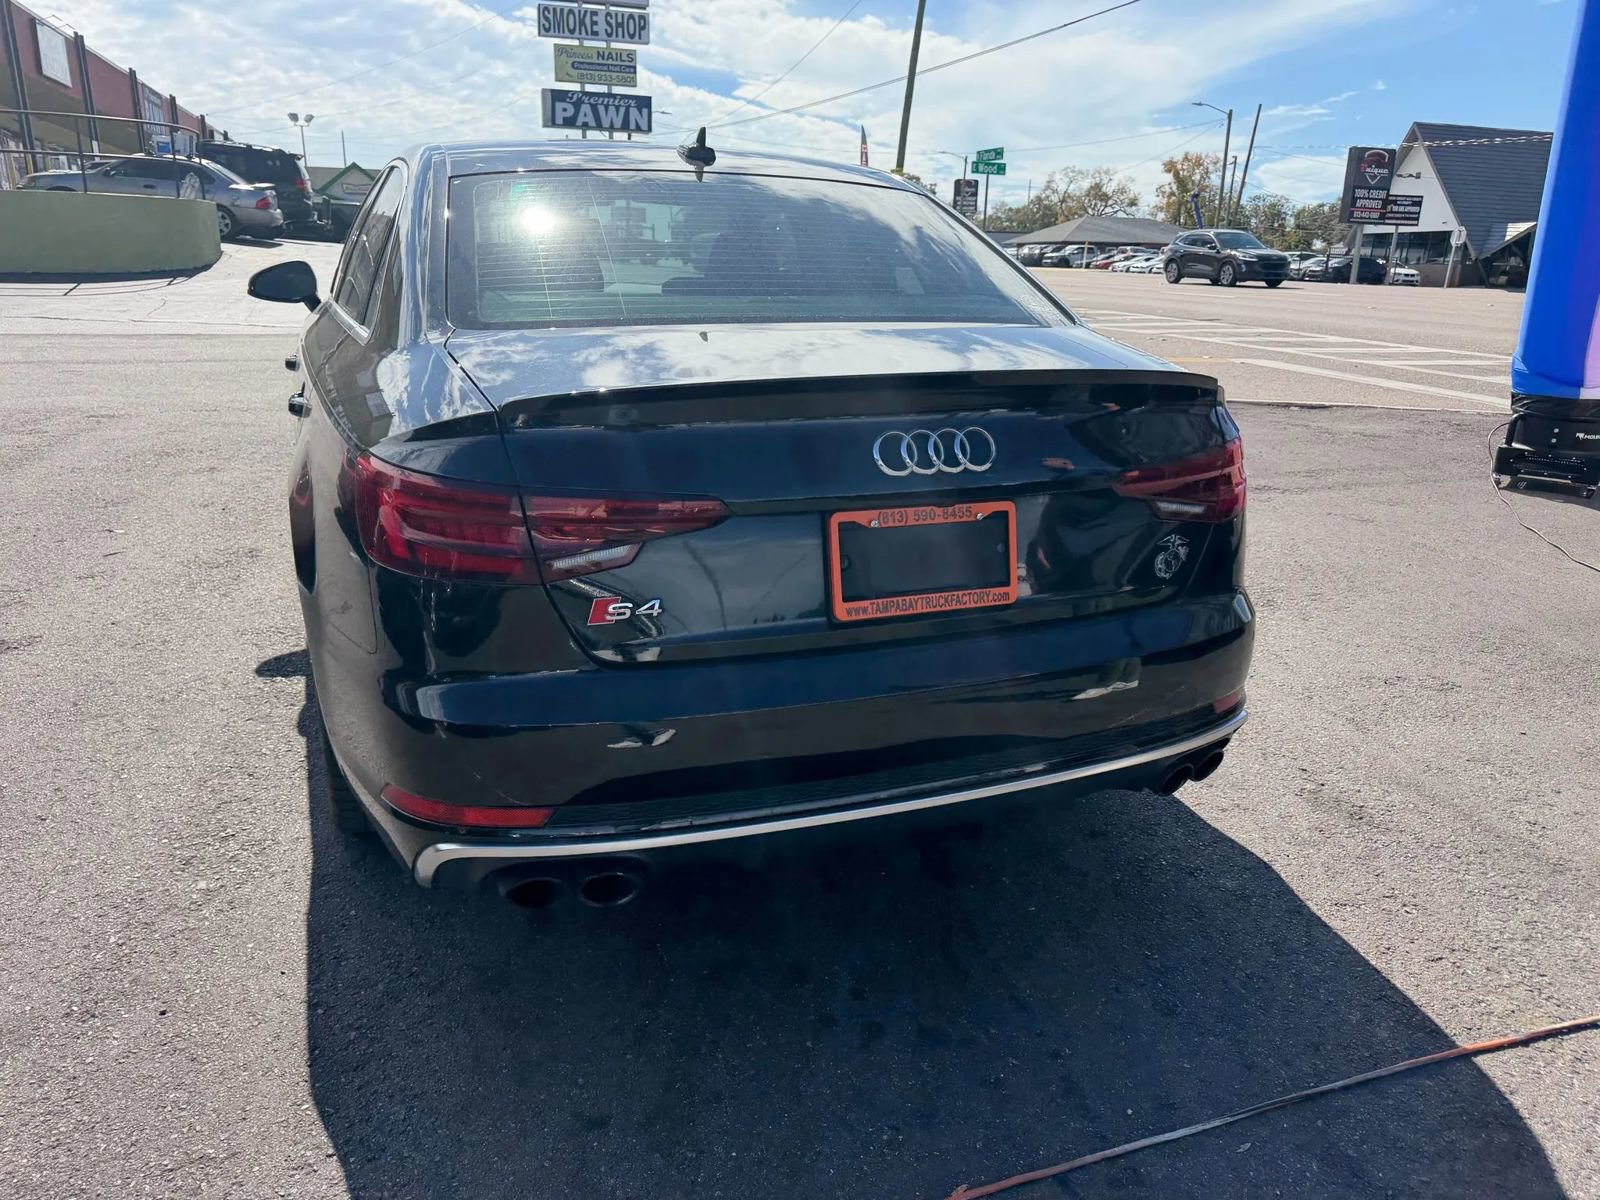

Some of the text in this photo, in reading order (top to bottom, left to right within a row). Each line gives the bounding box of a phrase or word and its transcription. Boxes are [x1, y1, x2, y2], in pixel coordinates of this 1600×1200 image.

[542, 5, 647, 40] SMOKE SHOP
[597, 50, 634, 63] NAILS
[577, 72, 596, 81] (813)
[566, 91, 638, 107] Premier
[555, 101, 649, 131] PAWN
[1369, 189, 1387, 199] CREDIT
[1355, 199, 1382, 209] APPROVED
[877, 506, 973, 525] (813) 590-8455
[845, 590, 1010, 618] www.TAMPABAYTRUCKFACTORY.com
